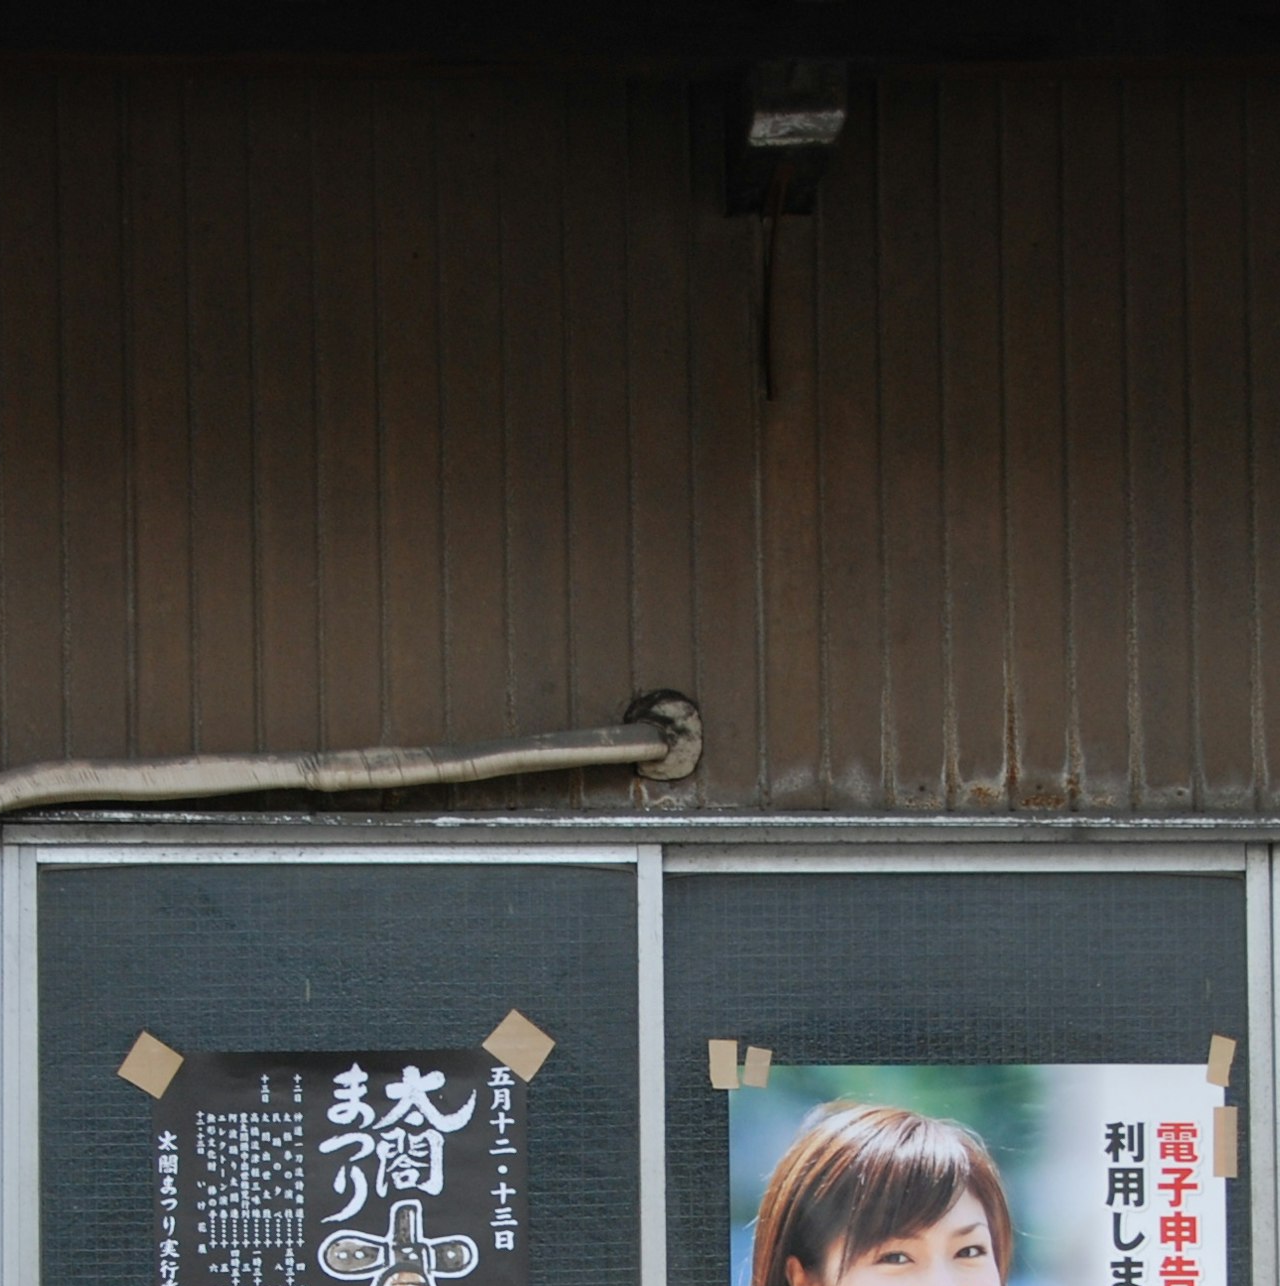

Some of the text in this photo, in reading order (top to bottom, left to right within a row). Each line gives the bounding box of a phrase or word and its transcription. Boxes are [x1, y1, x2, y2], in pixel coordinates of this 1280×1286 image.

[318, 1062, 376, 1224] まつり
[372, 1065, 477, 1198] 太閤
[487, 1066, 518, 1251] 五月十二・十三日
